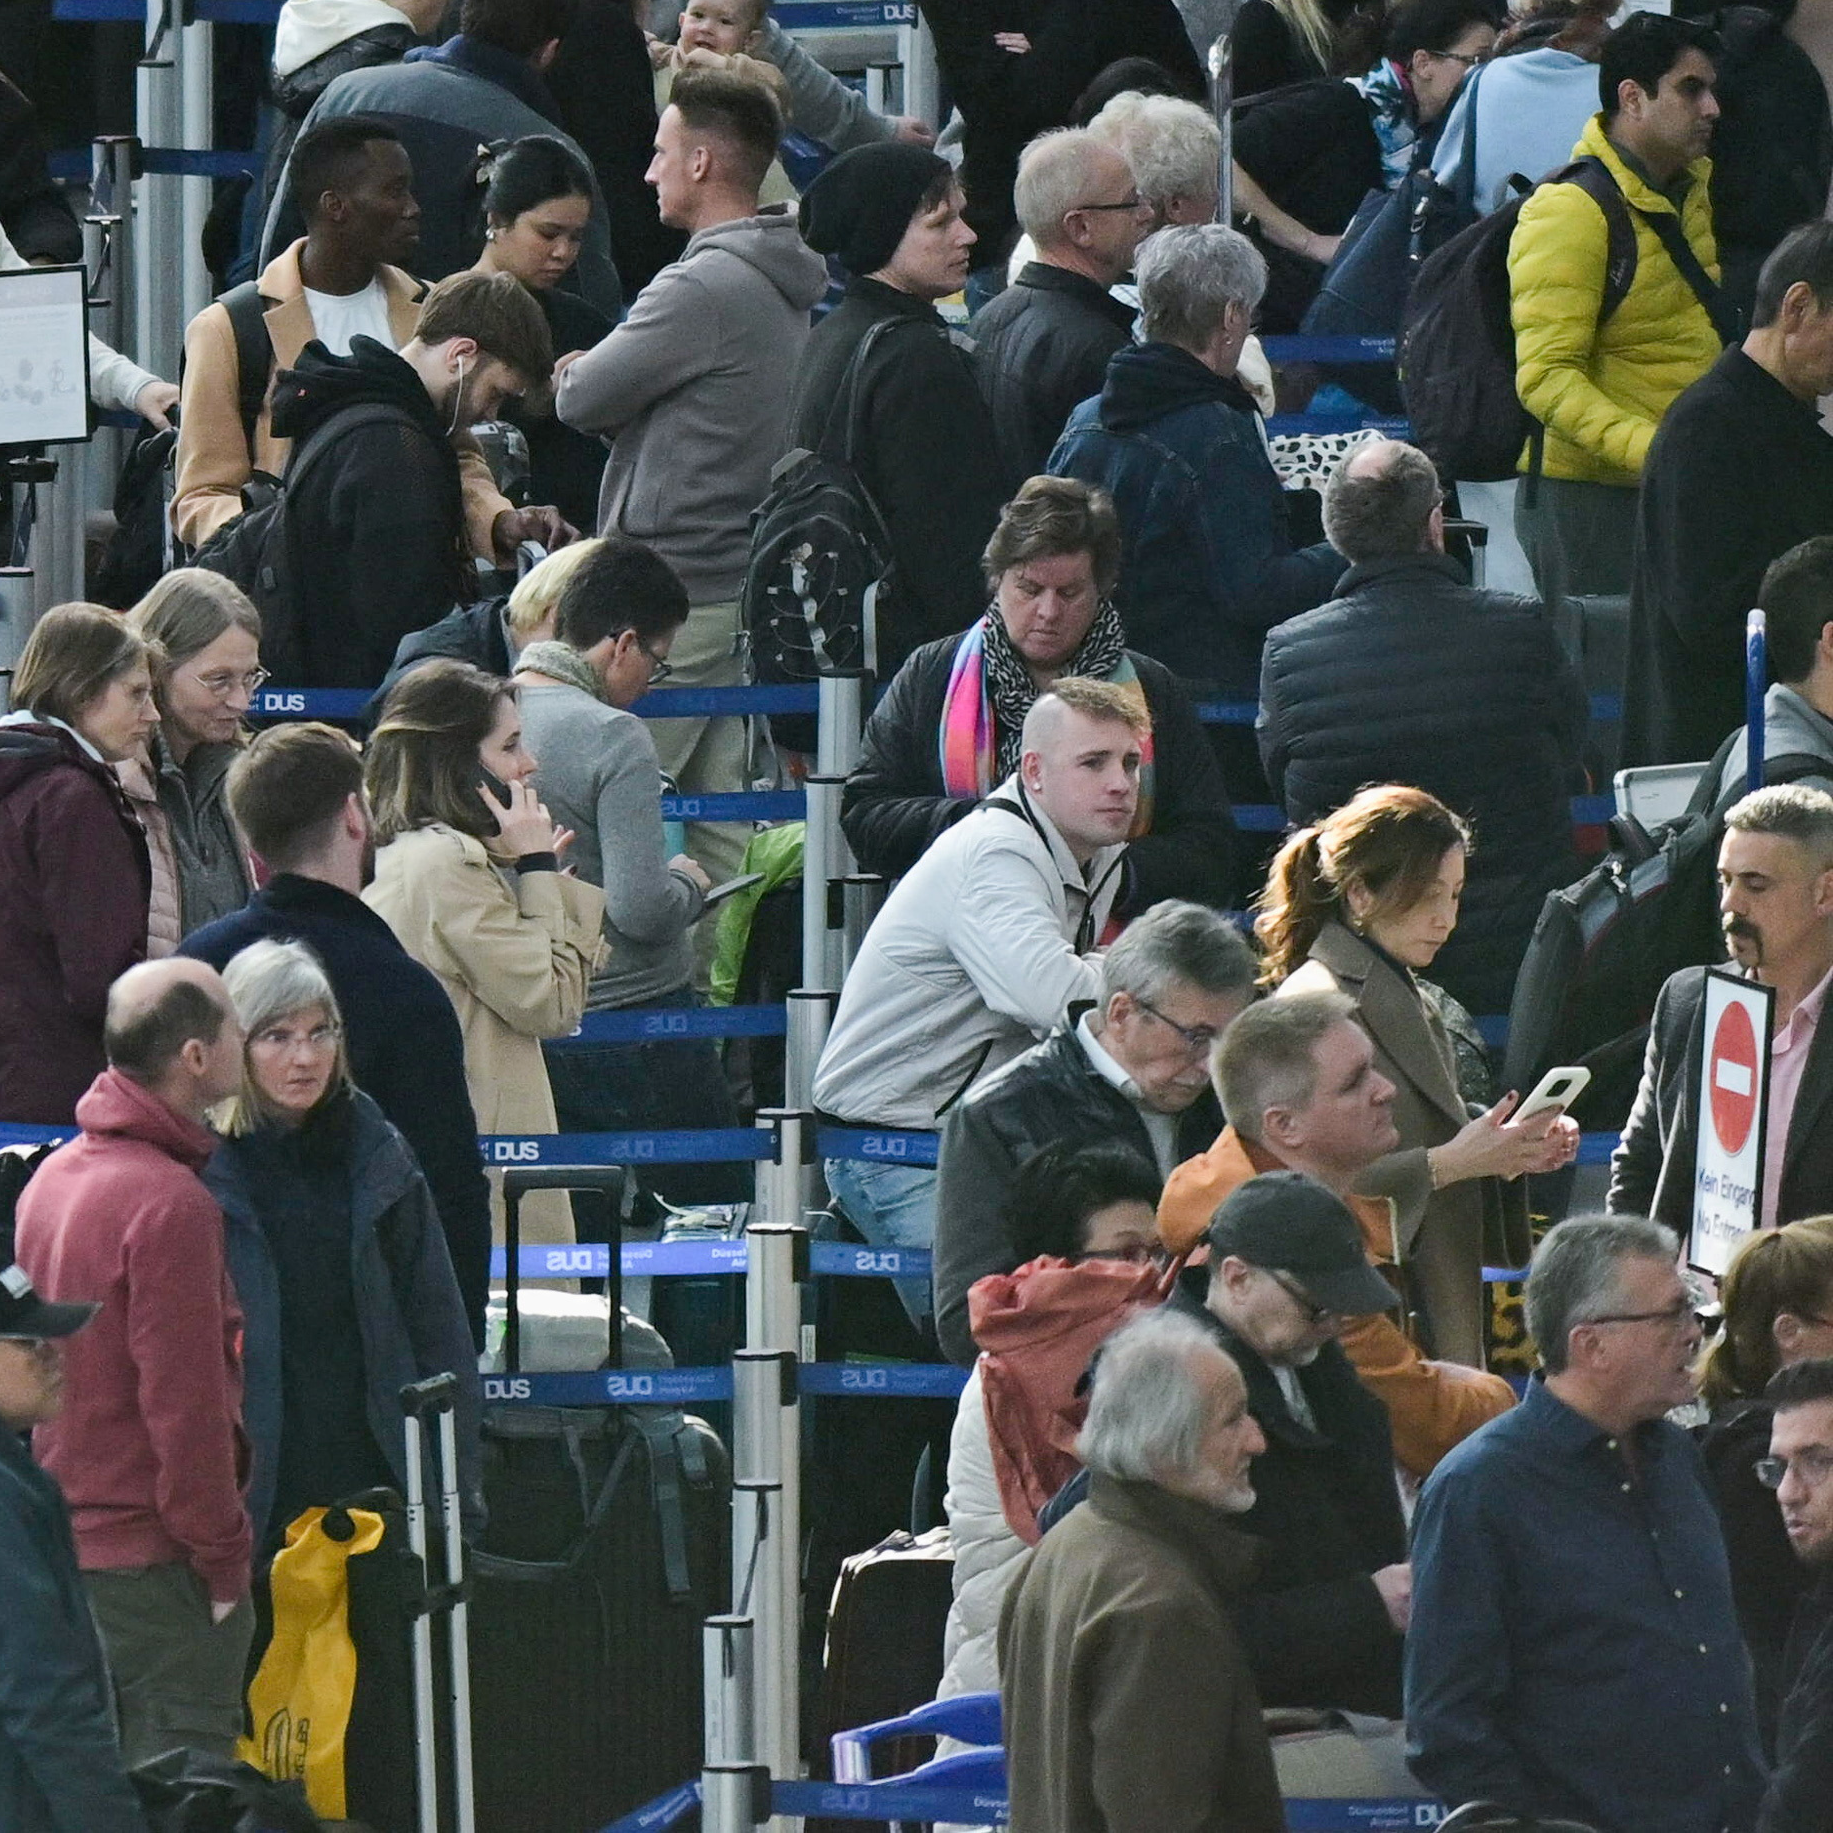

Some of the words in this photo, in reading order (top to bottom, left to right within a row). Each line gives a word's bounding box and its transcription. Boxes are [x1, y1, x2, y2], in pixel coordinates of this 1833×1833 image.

[883, 4, 915, 21] DUS
[264, 693, 306, 712] DUS
[494, 1140, 540, 1162] DUS
[1721, 1173, 1755, 1209] Eingan
[484, 1378, 532, 1400] DUS
[1415, 1804, 1450, 1827] DU
